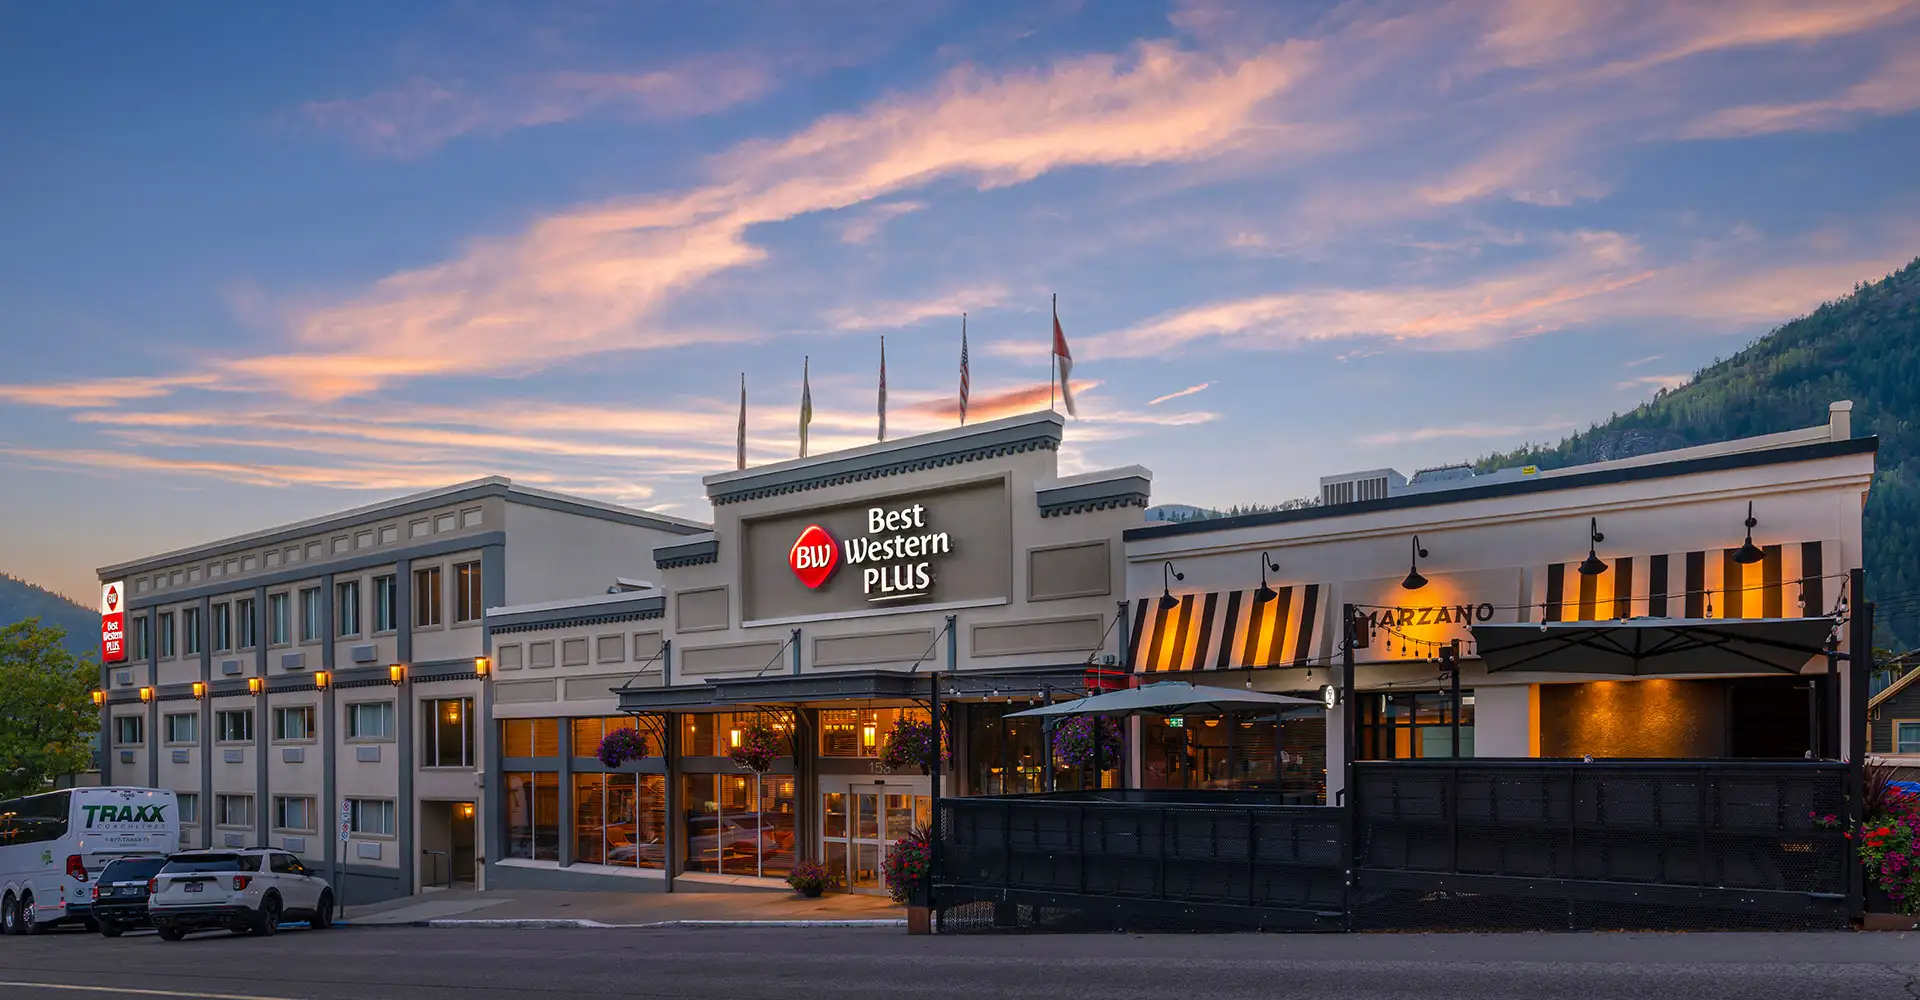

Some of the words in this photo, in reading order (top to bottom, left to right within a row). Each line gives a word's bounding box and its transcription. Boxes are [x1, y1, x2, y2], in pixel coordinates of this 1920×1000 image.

[868, 504, 925, 534] Best
[796, 544, 831, 569] BW
[845, 532, 950, 565] Western
[864, 562, 931, 594] PLUS
[103, 631, 123, 641] Western
[107, 621, 119, 631] Best
[106, 641, 120, 651] PLUS
[82, 803, 171, 829] TRAXX
